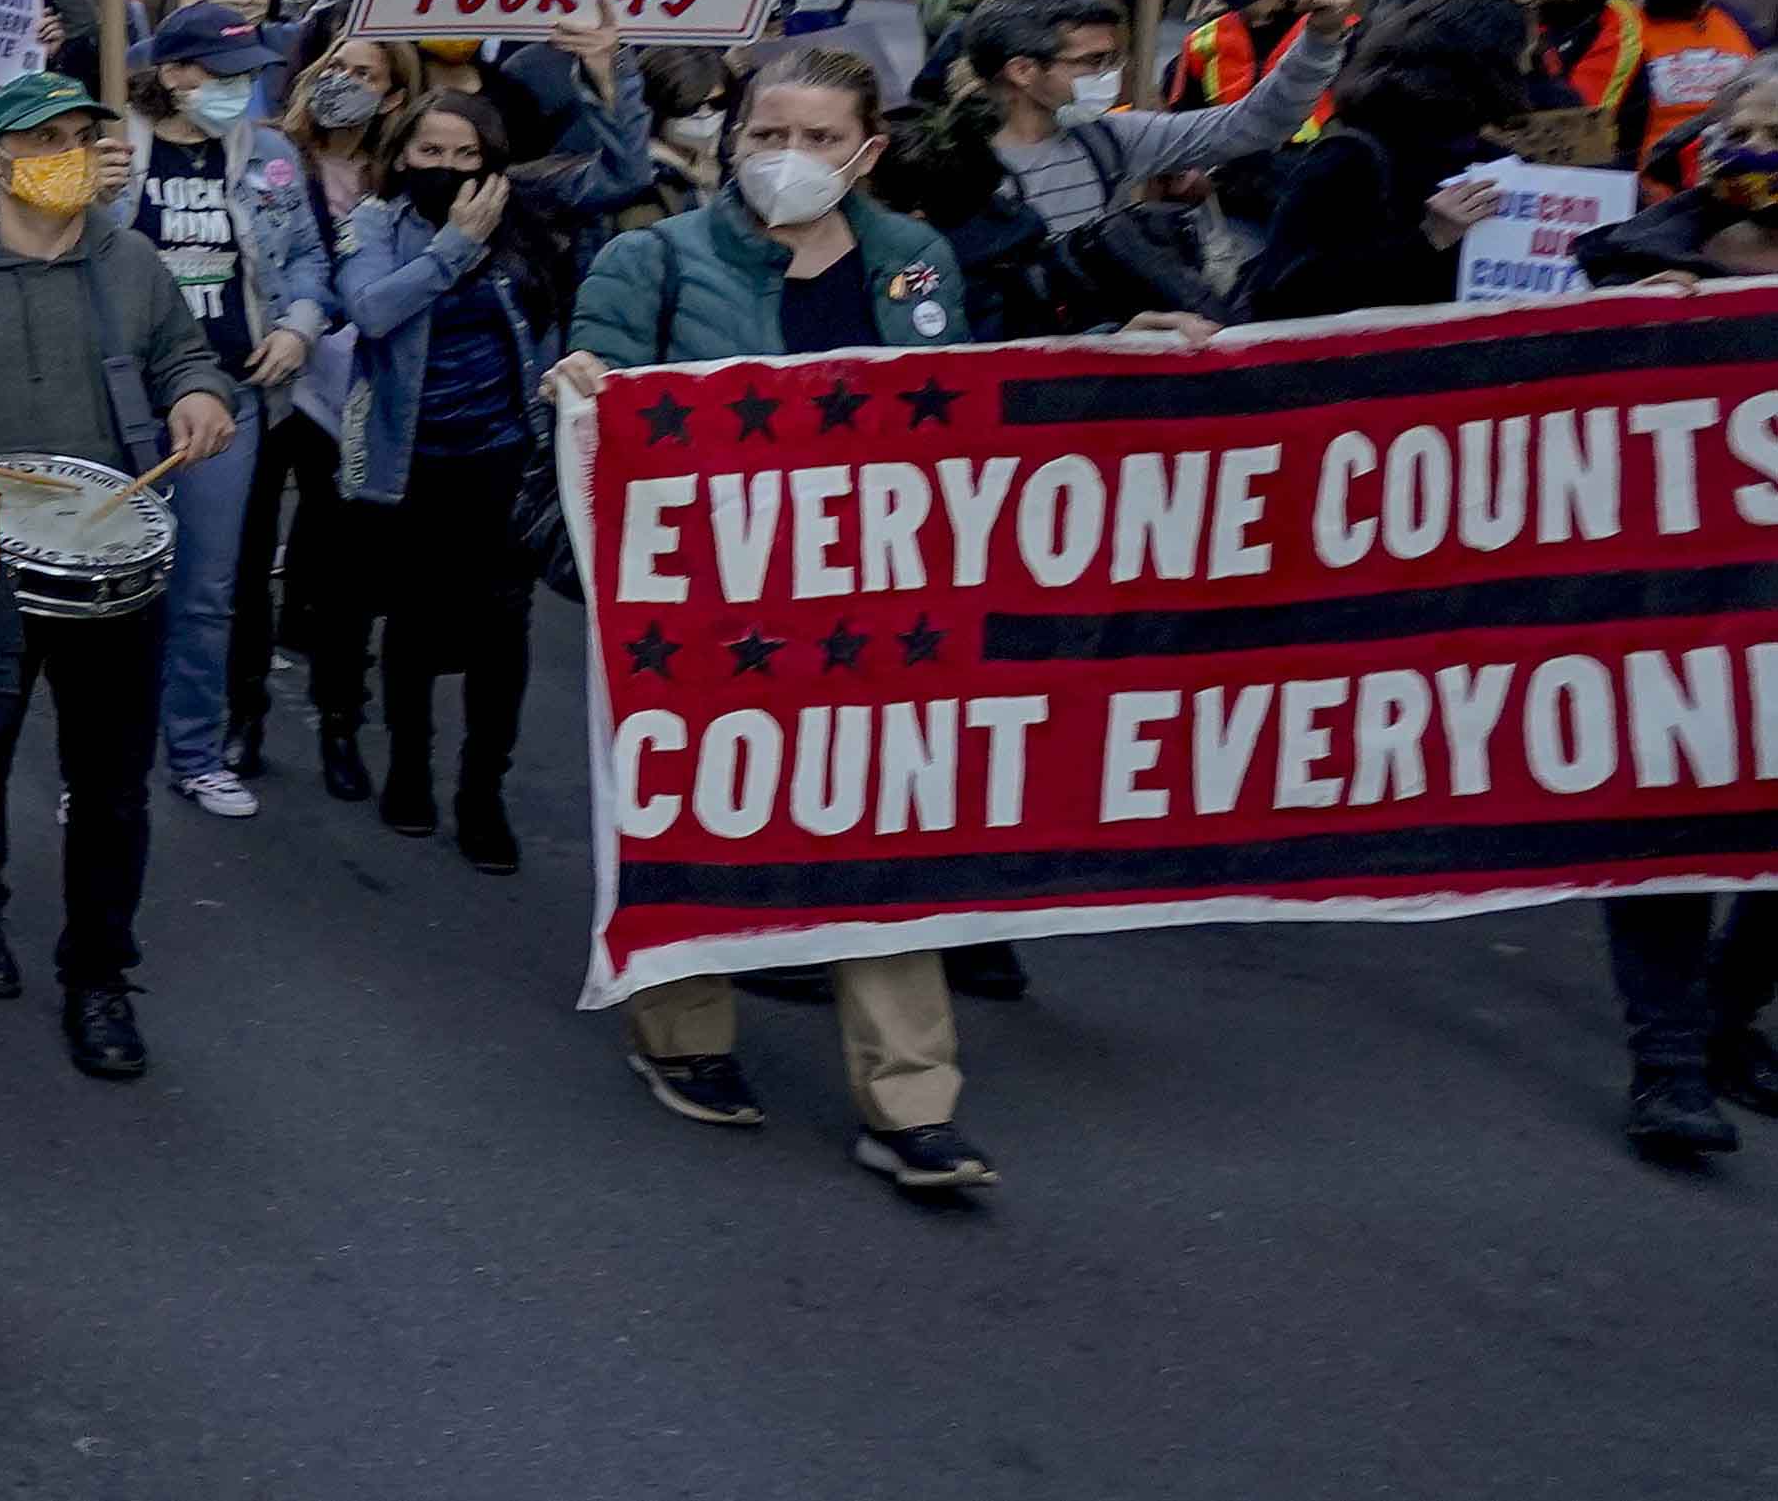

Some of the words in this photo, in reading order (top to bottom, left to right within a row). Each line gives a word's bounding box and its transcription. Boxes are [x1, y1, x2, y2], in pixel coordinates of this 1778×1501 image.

[1472, 258, 1581, 294] COUNT
[615, 441, 1284, 607] EVERYONE
[1312, 390, 1778, 569] COUNTS
[613, 696, 1048, 841] COUNT
